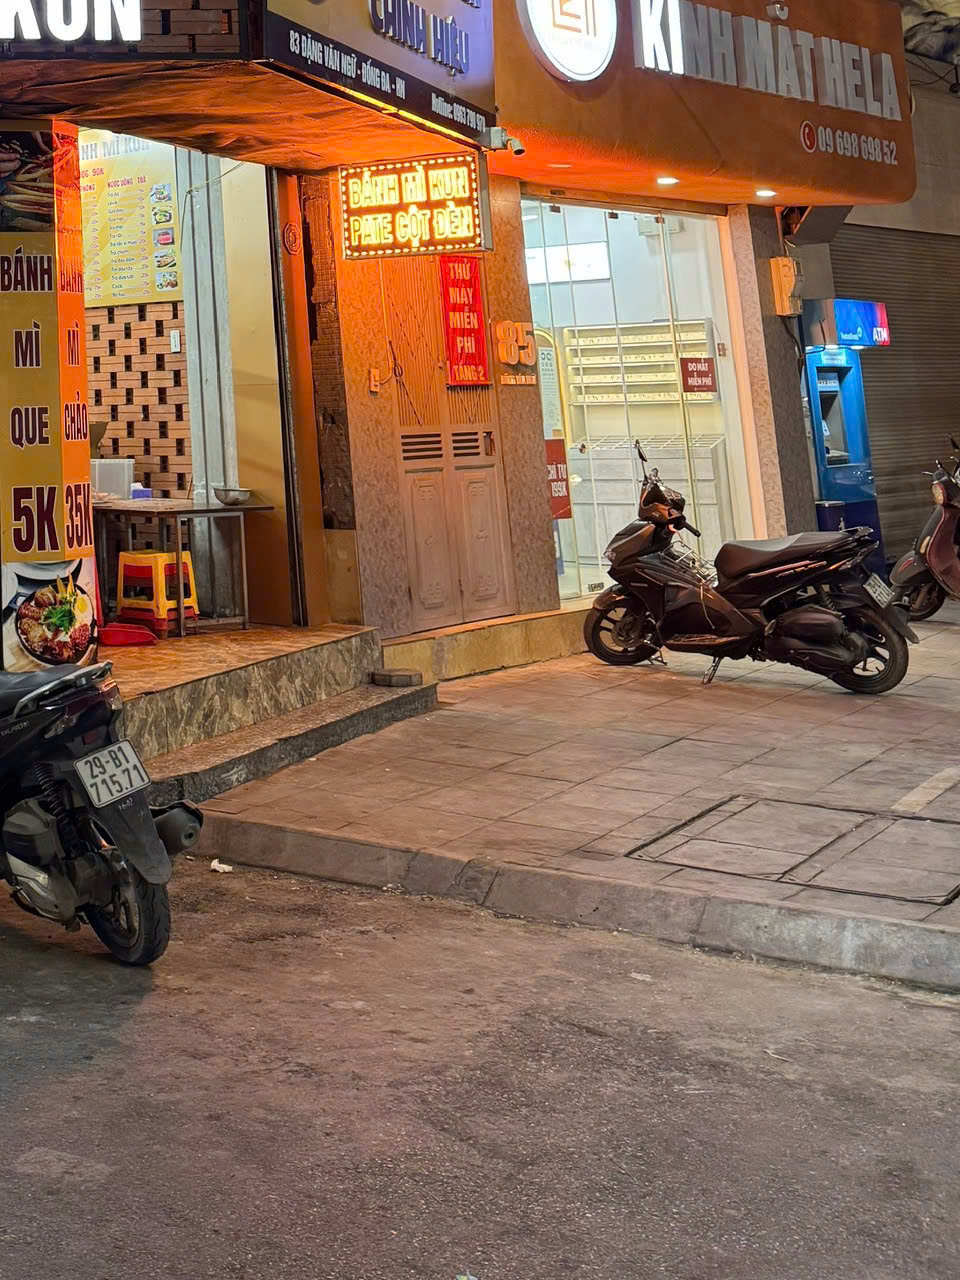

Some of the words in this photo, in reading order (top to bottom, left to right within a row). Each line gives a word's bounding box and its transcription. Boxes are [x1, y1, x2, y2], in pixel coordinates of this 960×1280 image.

[290, 30, 300, 55] 83
[301, 33, 323, 65] ĐẶNG
[324, 44, 340, 71] VĂN
[429, 15, 470, 77] HIỆU
[814, 36, 902, 121] HELA
[818, 125, 833, 158] 09
[835, 129, 859, 163] 698
[860, 134, 882, 168] 698
[882, 139, 898, 170] 52
[348, 170, 399, 208] BÁNH
[401, 165, 427, 202] MÌ
[428, 166, 470, 200] KUN
[349, 213, 394, 246] PATE
[433, 200, 474, 239] ĐÈN
[0, 244, 53, 294] BÁNH
[13, 324, 41, 368] MÌ
[66, 321, 81, 368] MÌ
[497, 320, 536, 366] 85
[873, 327, 888, 341] ATM
[478, 365, 485, 381] 2
[11, 407, 50, 446] QUE
[64, 392, 88, 442] CHẢO
[11, 485, 59, 553] 5K
[64, 482, 93, 548] 35K
[85, 746, 130, 779] 29-B1
[90, 764, 145, 803] 715.71
